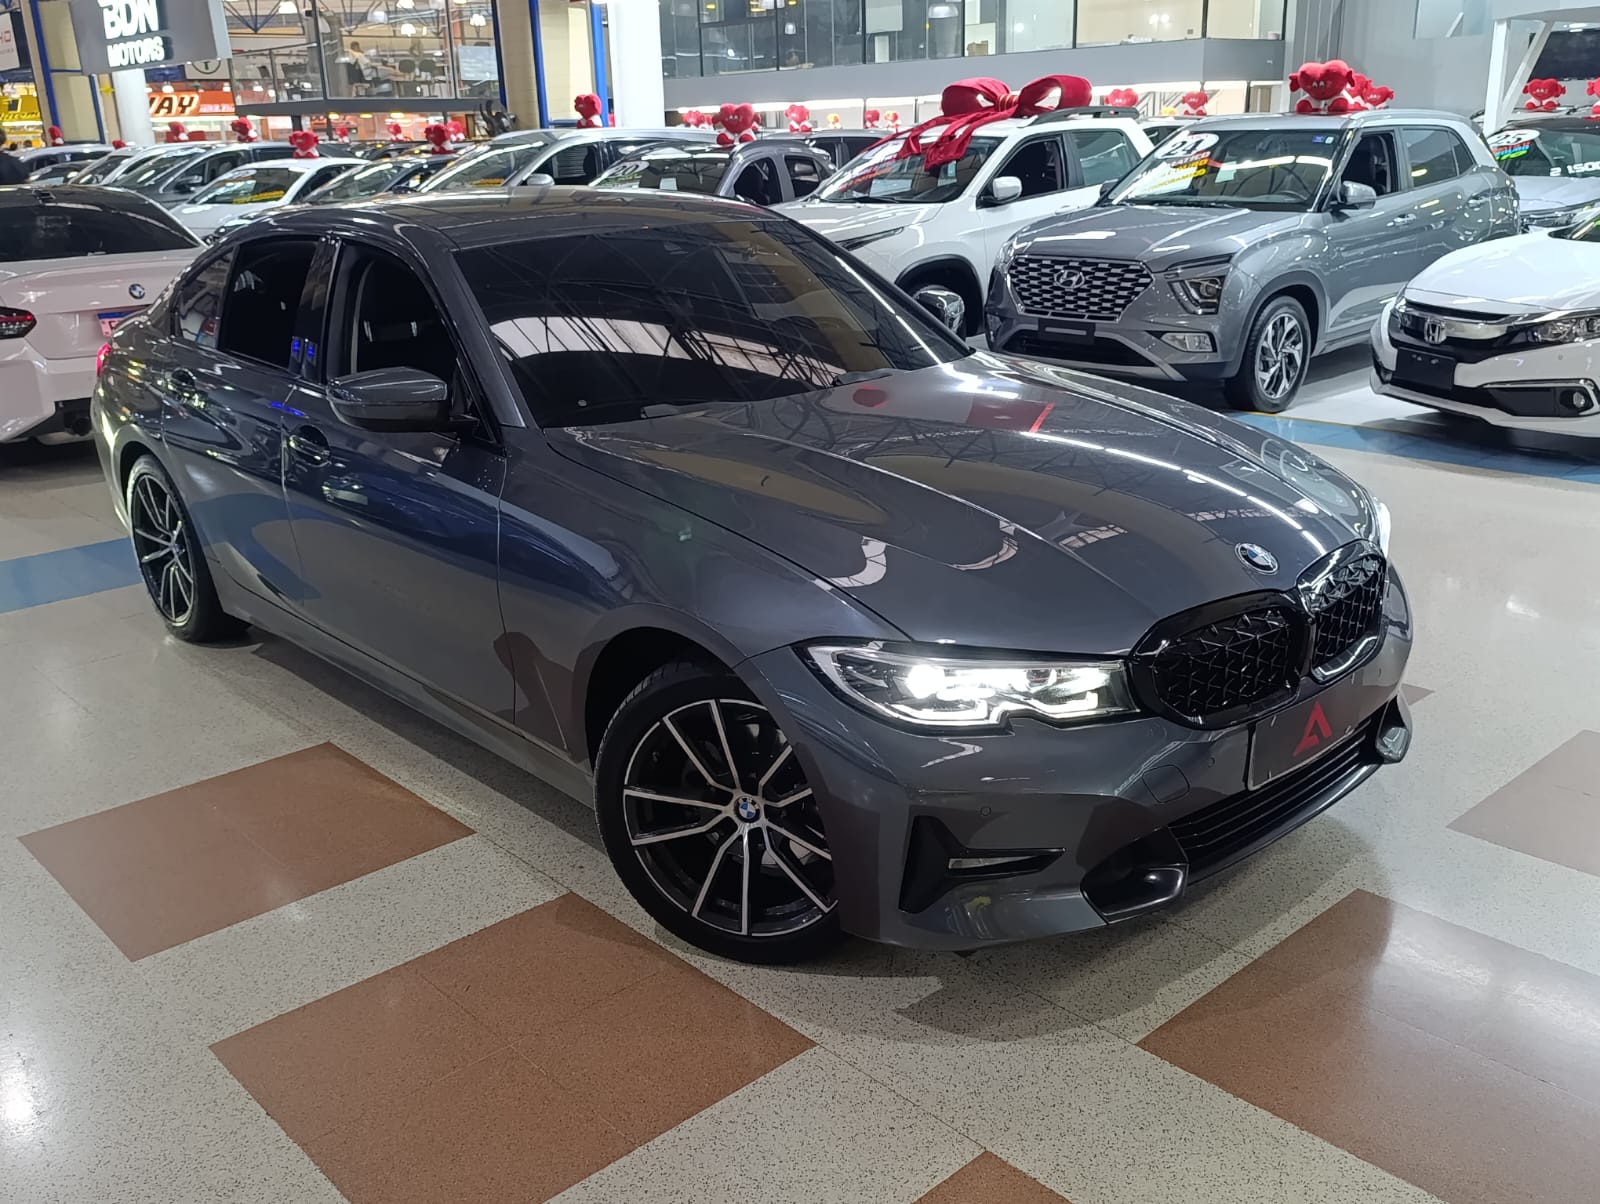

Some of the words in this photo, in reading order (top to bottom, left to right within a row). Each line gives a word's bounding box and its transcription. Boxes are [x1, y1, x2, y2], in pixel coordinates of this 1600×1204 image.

[98, 0, 159, 39] BDN
[107, 36, 165, 67] MOTORS
[148, 94, 200, 116] AY
